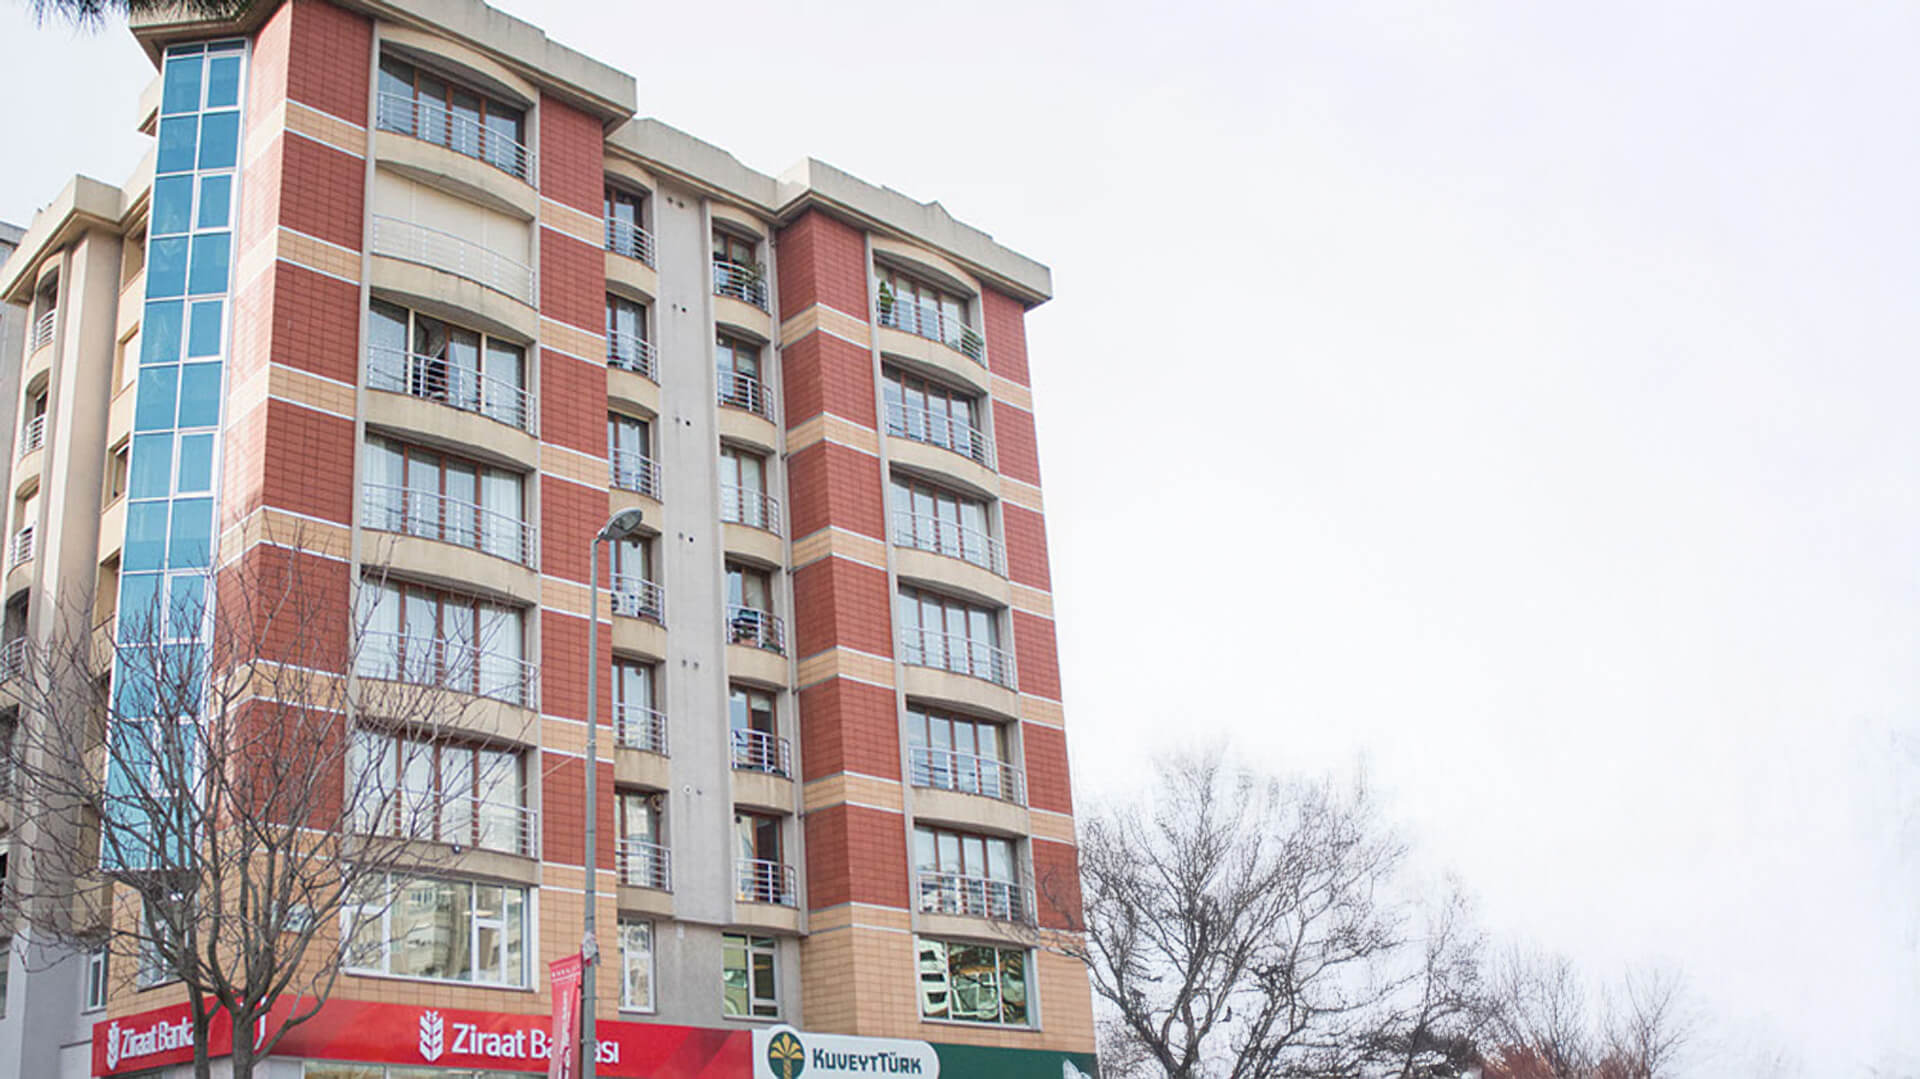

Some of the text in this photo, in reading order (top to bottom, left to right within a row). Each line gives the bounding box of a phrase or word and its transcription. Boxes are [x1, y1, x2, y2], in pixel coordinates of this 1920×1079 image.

[120, 1024, 157, 1059] Ziraat
[451, 1022, 526, 1058] Ziraat
[530, 1029, 620, 1064] Baası
